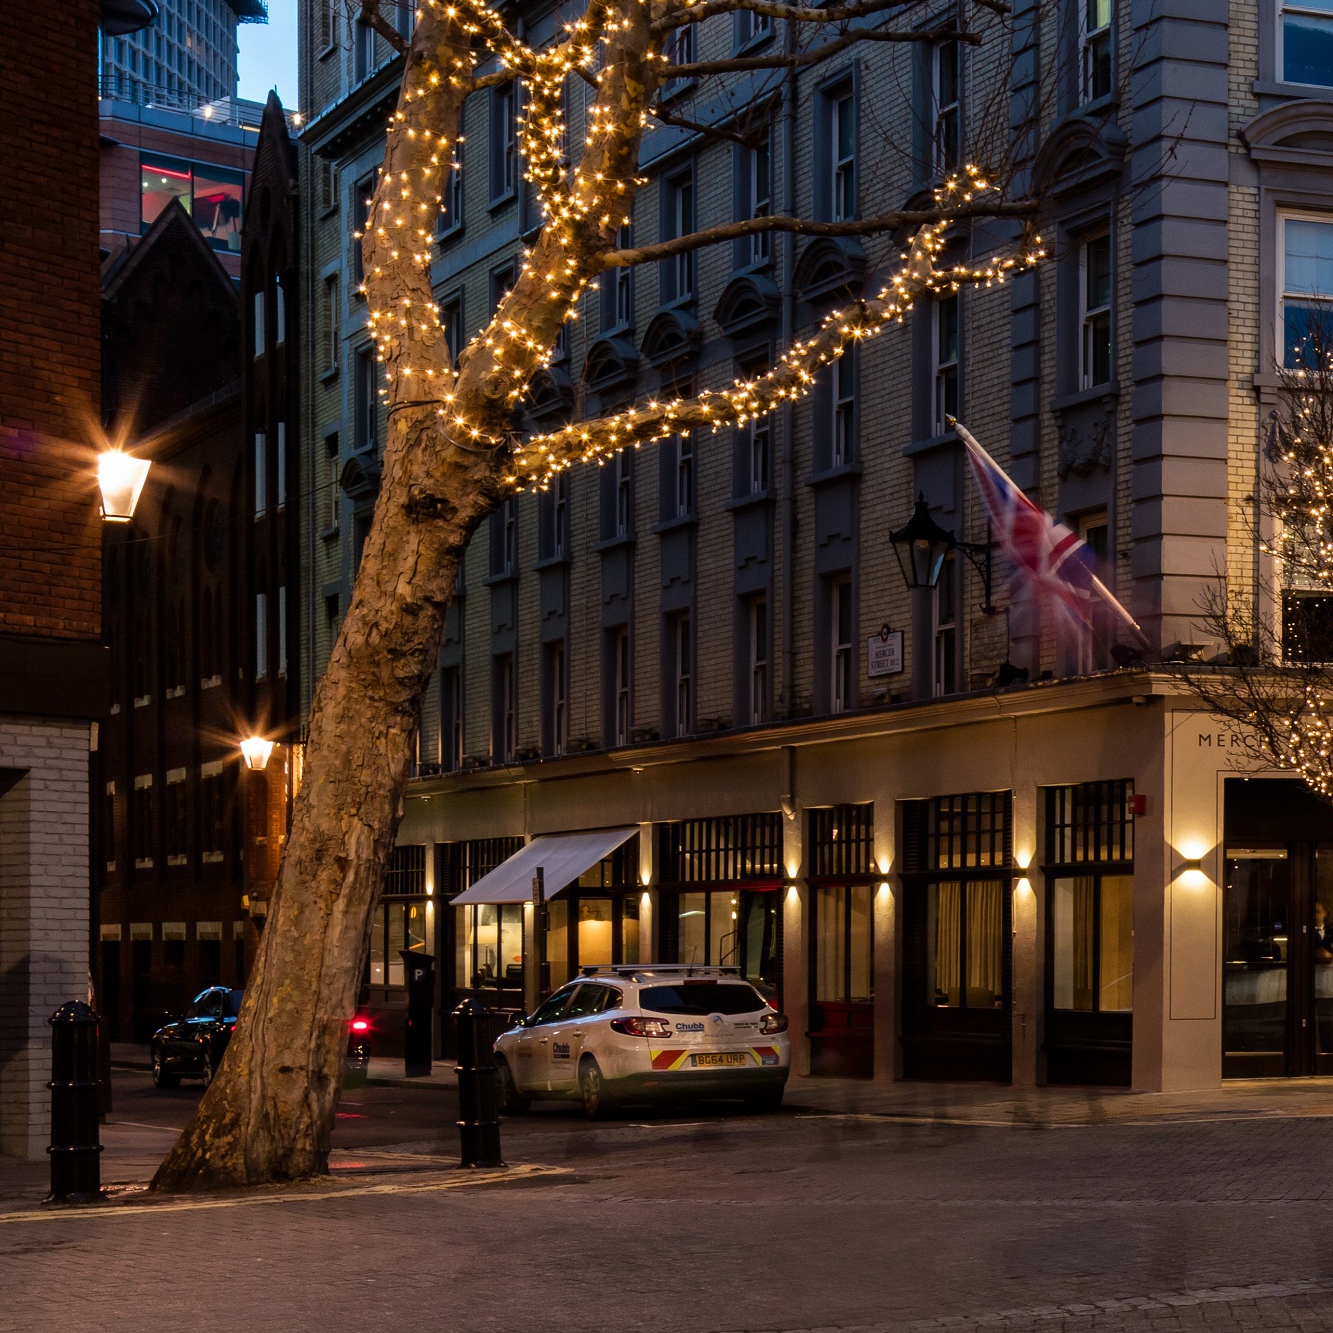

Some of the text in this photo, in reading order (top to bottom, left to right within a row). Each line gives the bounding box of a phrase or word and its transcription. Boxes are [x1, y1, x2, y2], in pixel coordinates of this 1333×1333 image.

[875, 648, 895, 659] MERCER
[871, 659, 889, 670] STREET
[414, 968, 423, 981] P
[676, 1022, 704, 1030] Chubb
[698, 1054, 745, 1065] BG64 URP
